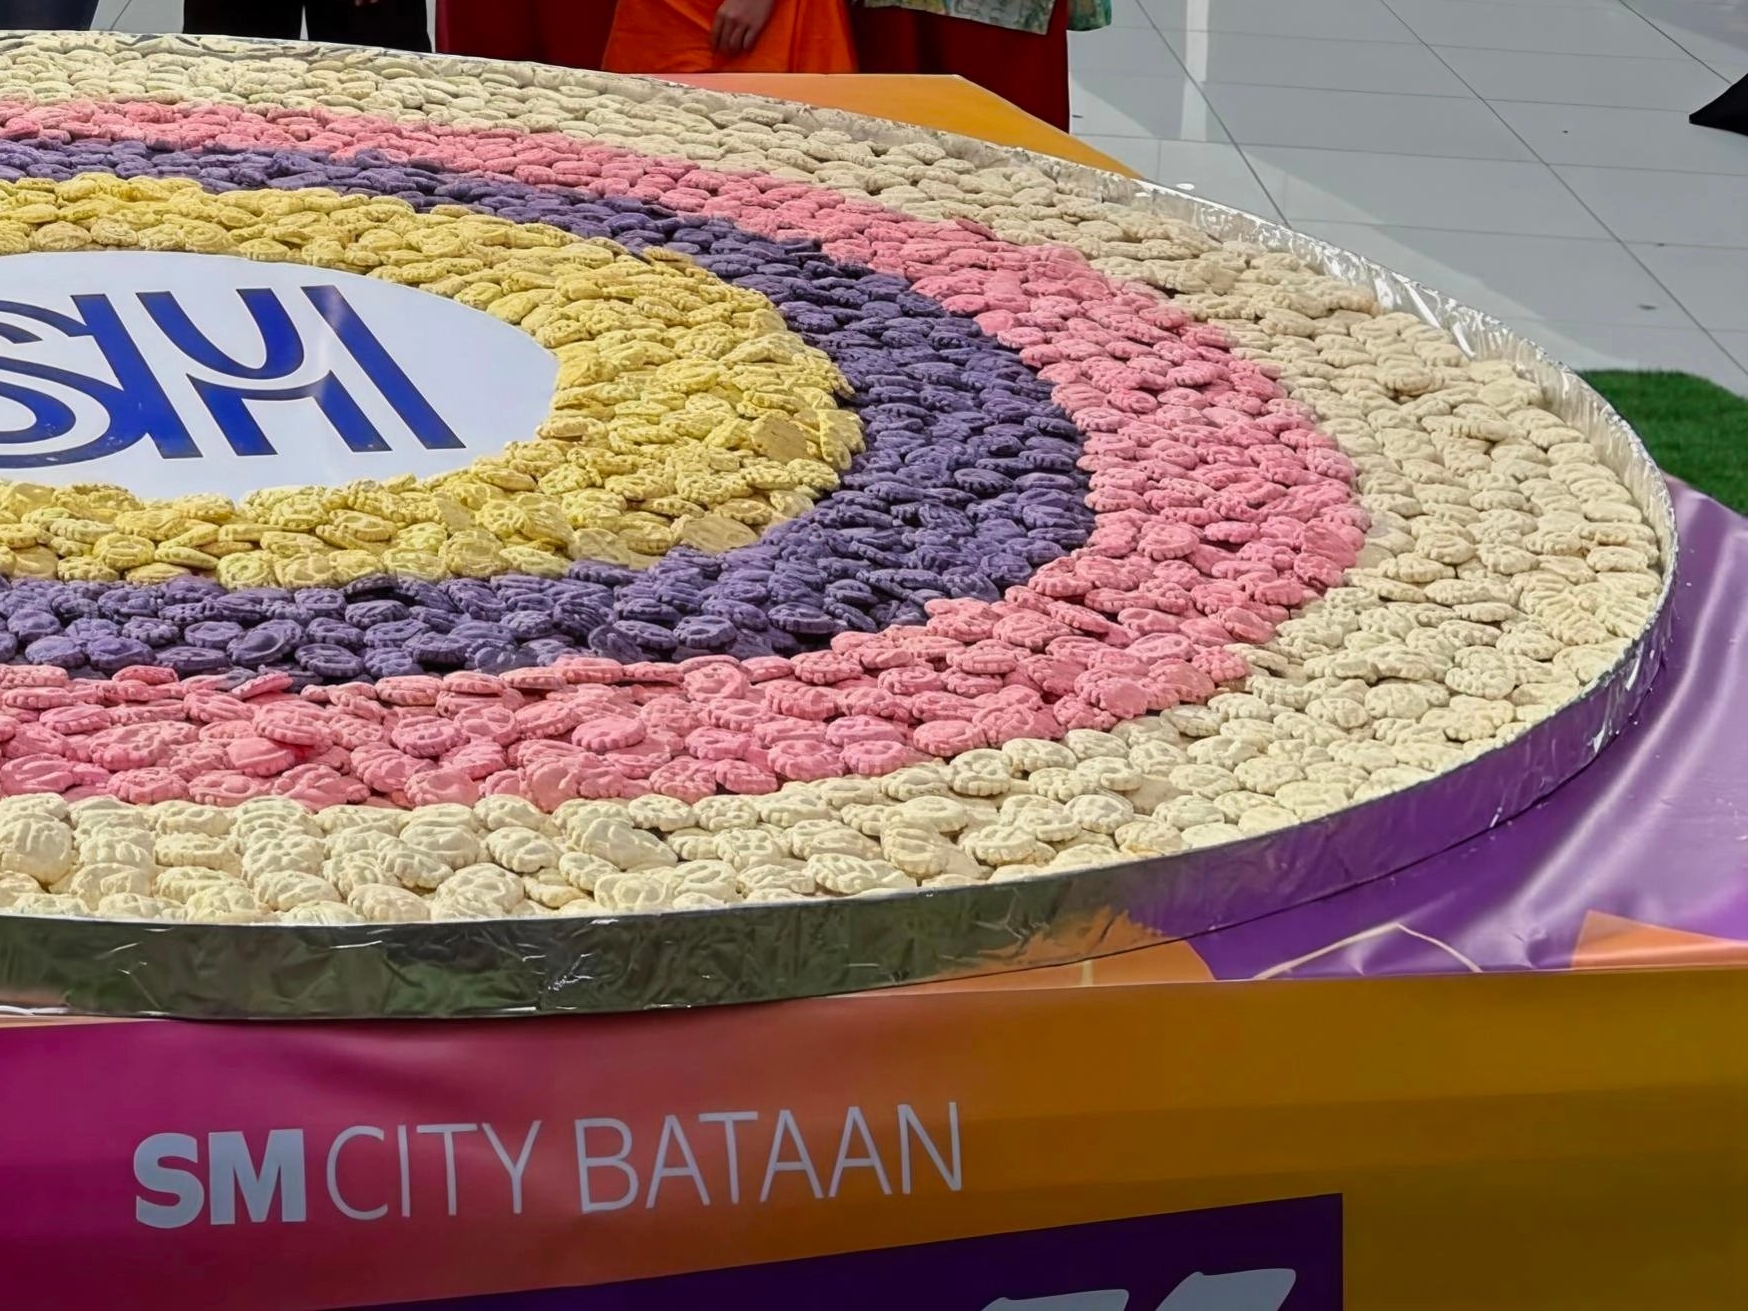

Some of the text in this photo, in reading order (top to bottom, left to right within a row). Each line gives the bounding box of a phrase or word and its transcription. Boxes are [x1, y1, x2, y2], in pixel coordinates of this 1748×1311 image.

[133, 1101, 964, 1230] SM CITY BATAAN
